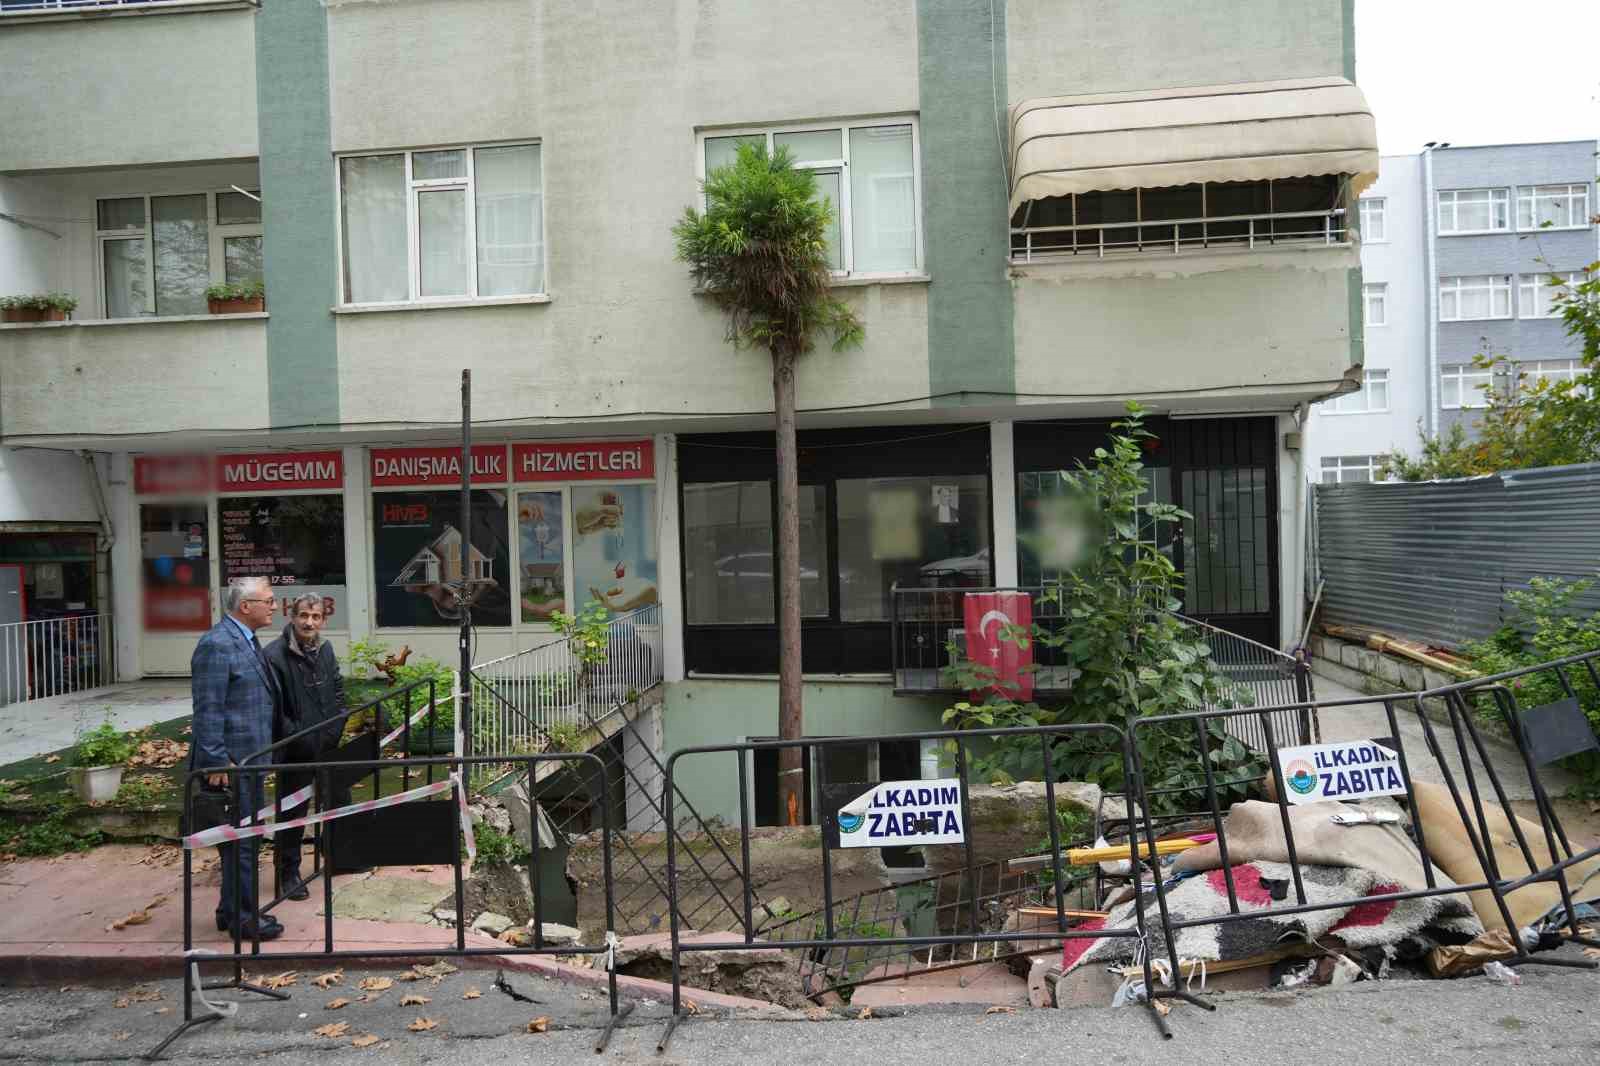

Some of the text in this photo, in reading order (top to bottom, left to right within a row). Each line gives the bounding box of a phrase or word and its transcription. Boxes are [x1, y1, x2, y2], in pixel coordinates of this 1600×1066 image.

[224, 459, 337, 482] MÜGEMM
[374, 447, 642, 481] DANIŞMALIK HİZMETLERİ
[1320, 766, 1402, 797] ZABITA
[868, 787, 959, 809] LKADIM
